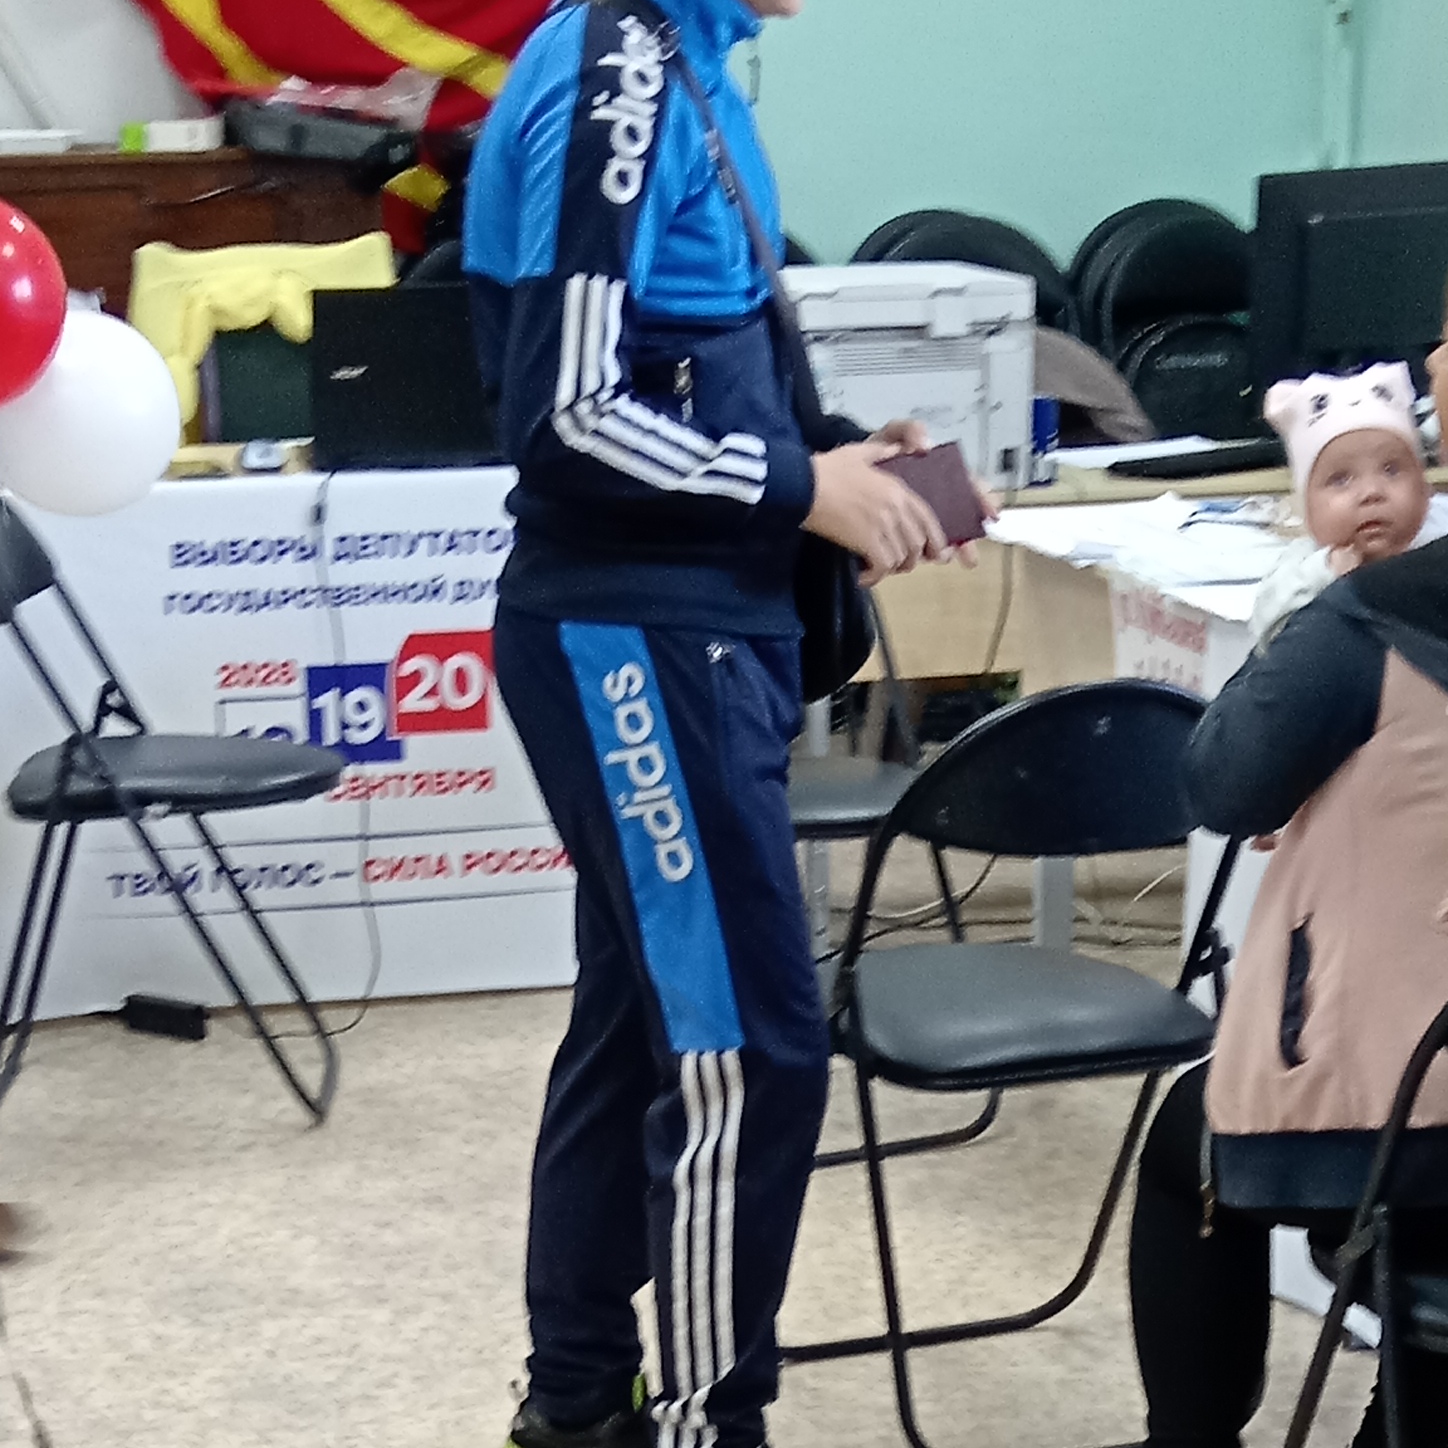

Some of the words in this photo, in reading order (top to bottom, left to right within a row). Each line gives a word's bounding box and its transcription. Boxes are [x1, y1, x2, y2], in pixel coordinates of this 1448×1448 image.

[169, 536, 319, 569] ВЫБОРЫ
[163, 574, 448, 615] ГОСУДАРСТВЕННОЙ
[397, 651, 487, 714] 20
[311, 685, 386, 746] 19
[602, 661, 694, 883] adidas
[362, 854, 448, 885] СИЛА
